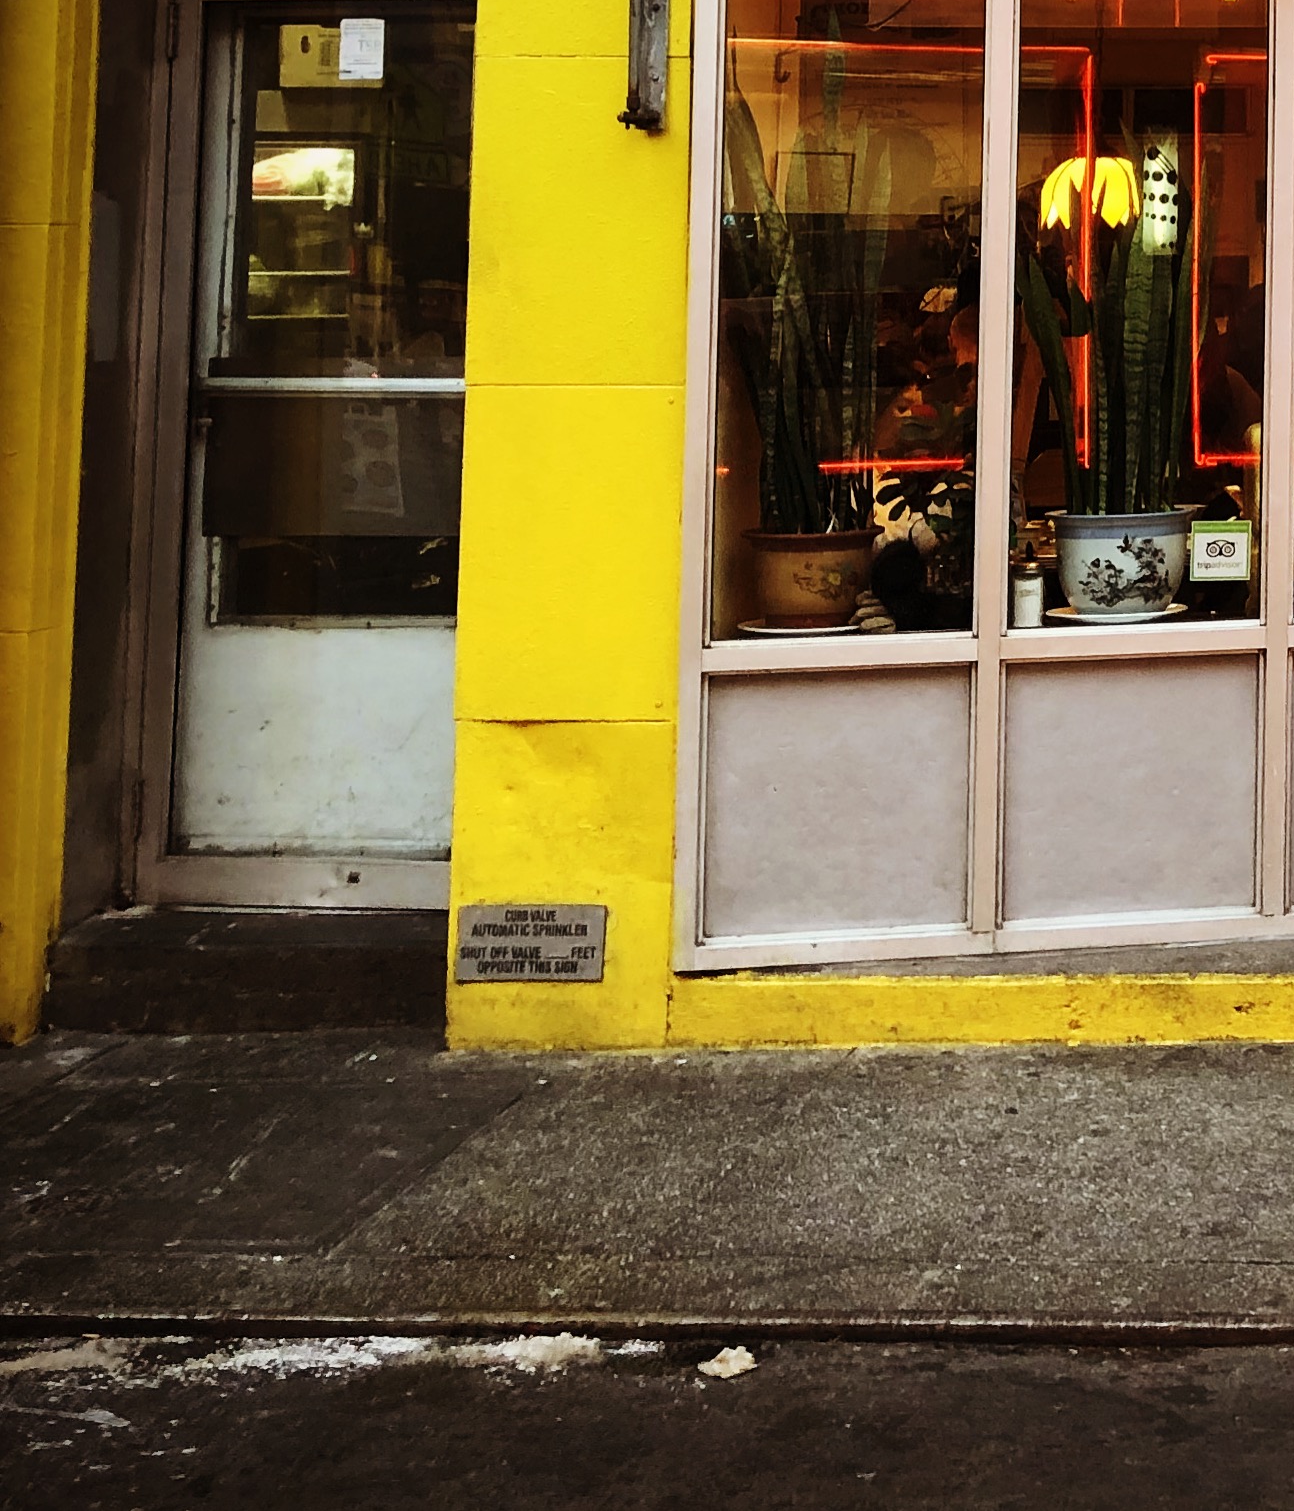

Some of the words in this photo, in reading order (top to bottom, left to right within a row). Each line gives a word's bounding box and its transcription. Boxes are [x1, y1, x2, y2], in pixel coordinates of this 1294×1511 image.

[505, 909, 529, 922] CURB
[530, 909, 557, 922] VALVE
[471, 923, 530, 937] AUTOMATIC
[532, 923, 588, 937] SPRINKLER
[460, 946, 487, 960] SHUT
[490, 946, 509, 959] OFF
[512, 946, 542, 959] VALVE
[570, 946, 597, 959] FEET
[477, 960, 526, 974] OPPOSITE
[529, 960, 552, 973] THIS
[554, 960, 579, 974] SIGN
